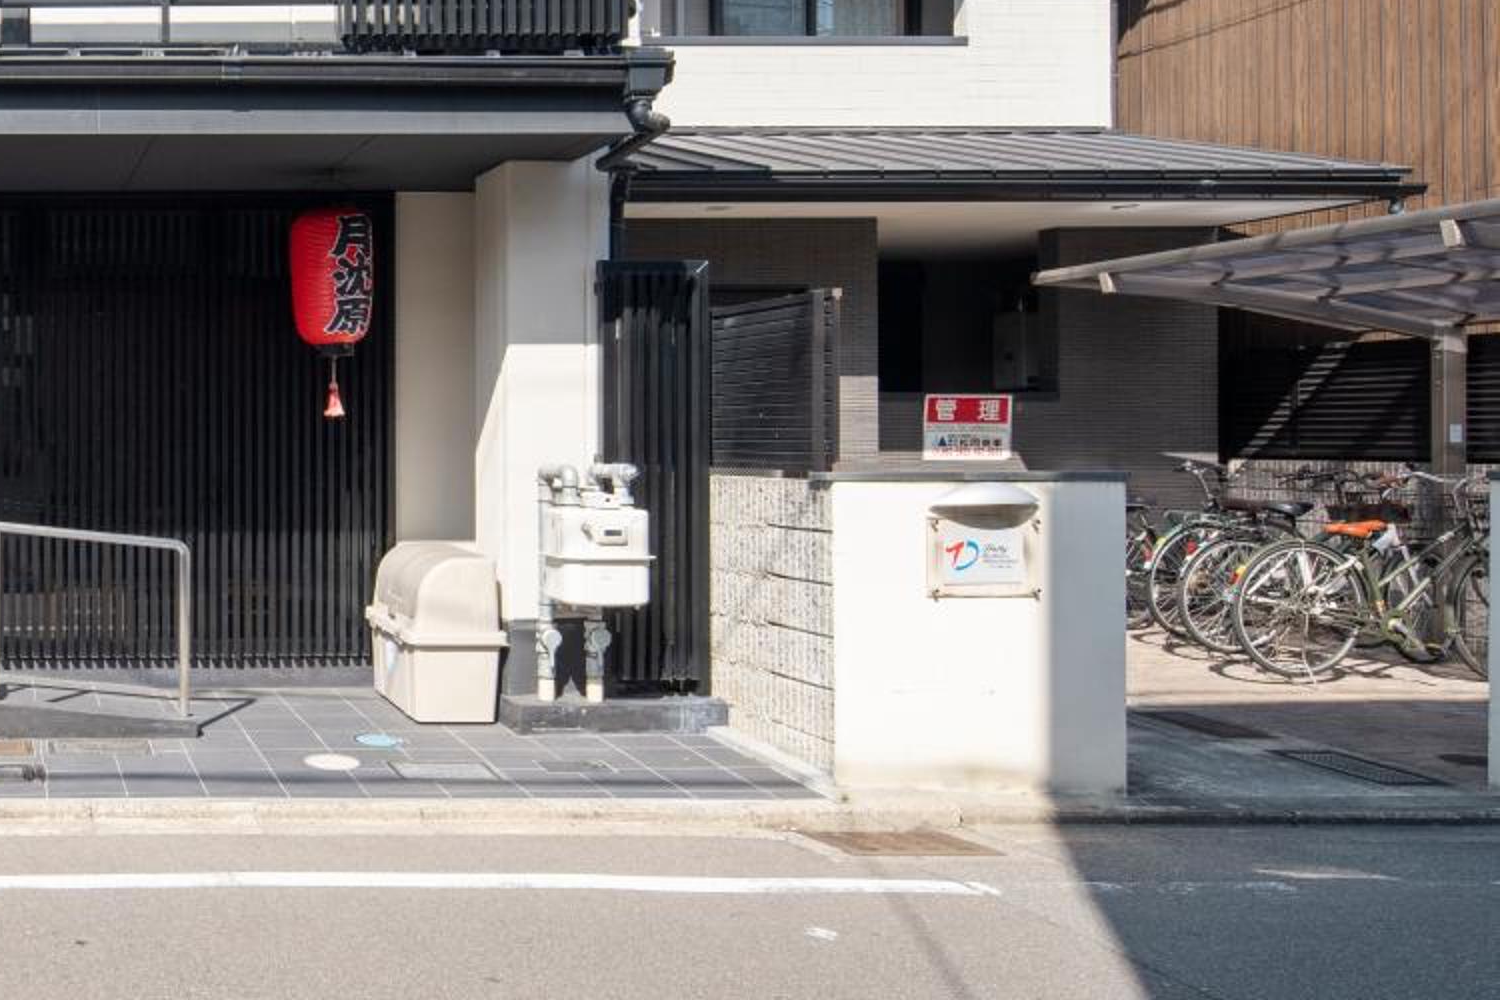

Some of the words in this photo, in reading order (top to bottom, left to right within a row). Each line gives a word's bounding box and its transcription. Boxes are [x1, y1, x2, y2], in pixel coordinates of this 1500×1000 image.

[323, 213, 373, 335] 月沈原
[935, 399, 1001, 421] 管理
